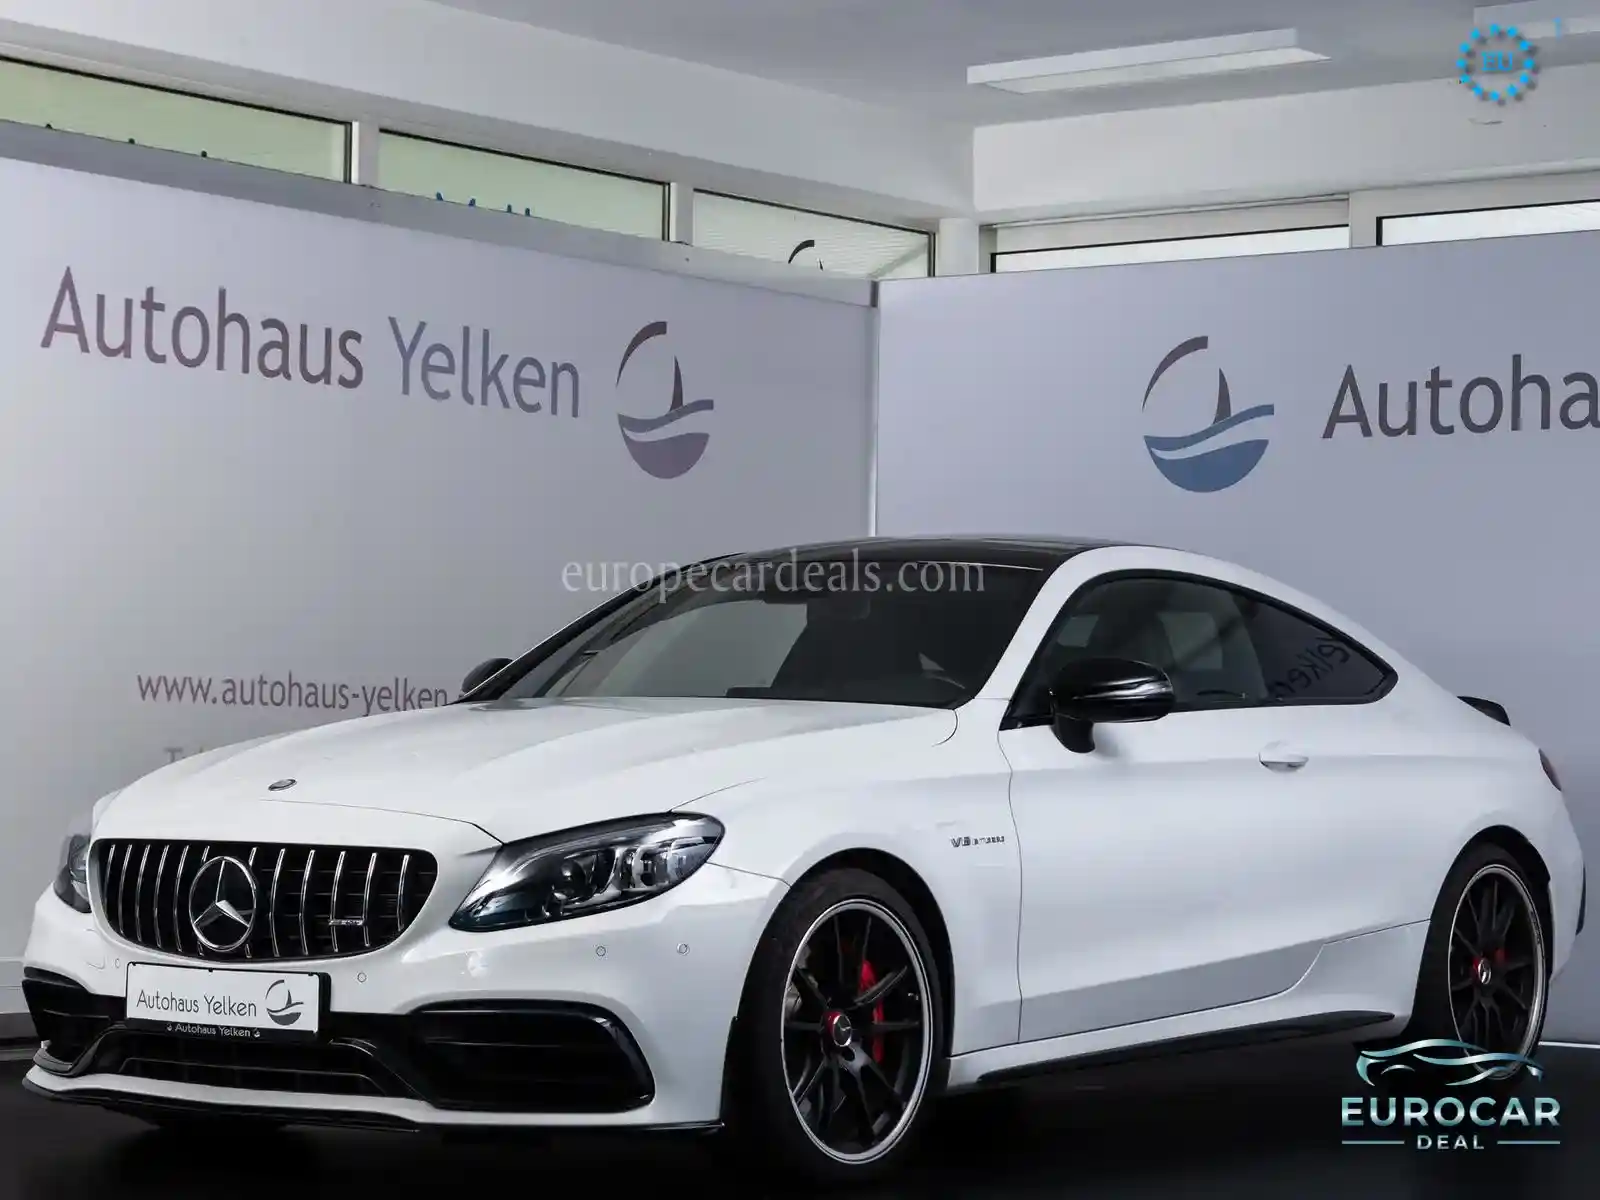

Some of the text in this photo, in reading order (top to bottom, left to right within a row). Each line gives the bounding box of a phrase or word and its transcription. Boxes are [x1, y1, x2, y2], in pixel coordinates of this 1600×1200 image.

[40, 265, 580, 418] Autohaus Yelken
[1321, 353, 1600, 439] Autoha
[136, 989, 257, 1017] Autohaus Yelken
[174, 1023, 251, 1037] Autohaus Yelken
